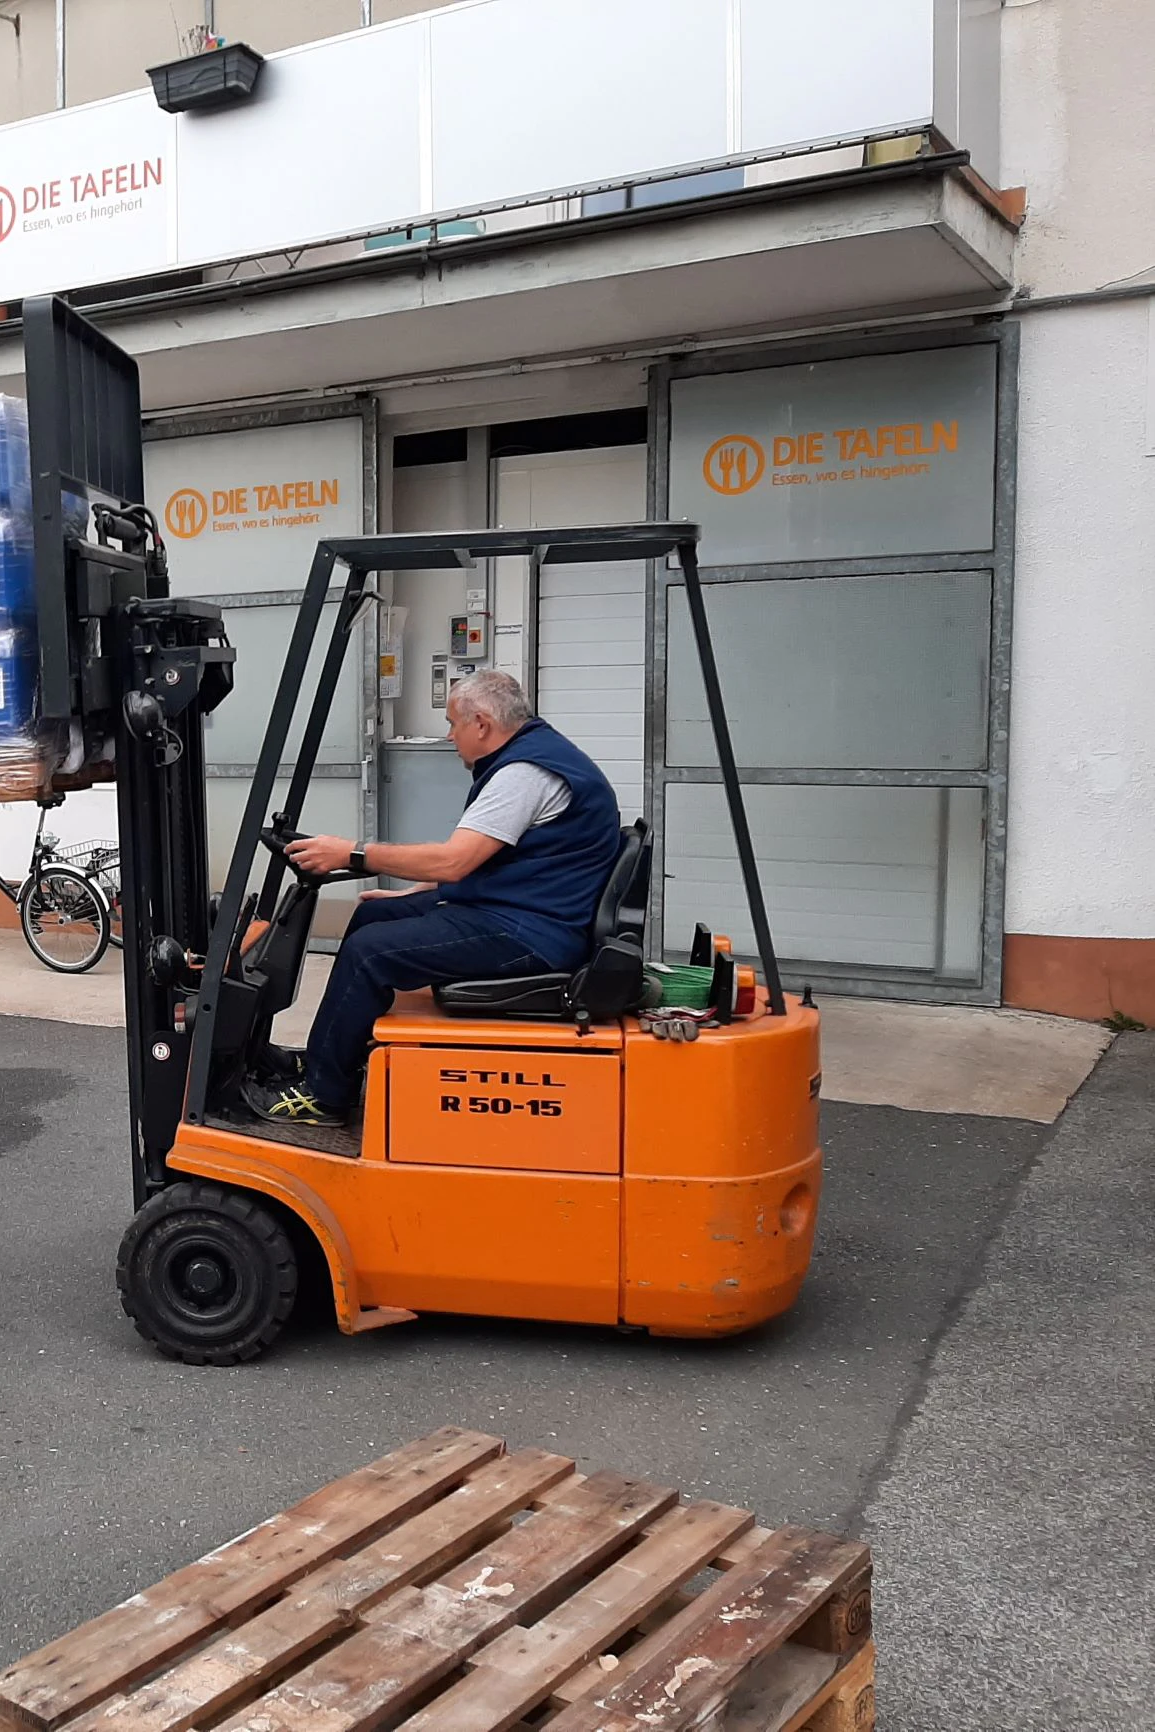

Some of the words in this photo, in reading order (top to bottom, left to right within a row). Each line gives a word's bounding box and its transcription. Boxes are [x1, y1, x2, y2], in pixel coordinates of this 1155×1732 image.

[23, 180, 61, 214] DIE
[70, 157, 162, 203] TAFELN
[22, 217, 53, 232] Essen,
[57, 214, 73, 225] wo
[76, 211, 87, 221] es
[90, 197, 143, 219] hingehört
[773, 432, 825, 467] DIE
[833, 420, 959, 461] TAFELN
[772, 473, 812, 486] Essen,
[816, 471, 837, 482] wo
[841, 469, 855, 480] es
[212, 488, 248, 516] DIE
[253, 479, 339, 512] TAFELN
[212, 520, 240, 532] Essen,
[242, 520, 257, 529] wo
[259, 518, 269, 528] es
[440, 1069, 566, 1087] STILL
[440, 1096, 461, 1112] R
[469, 1096, 563, 1117] 50-15
